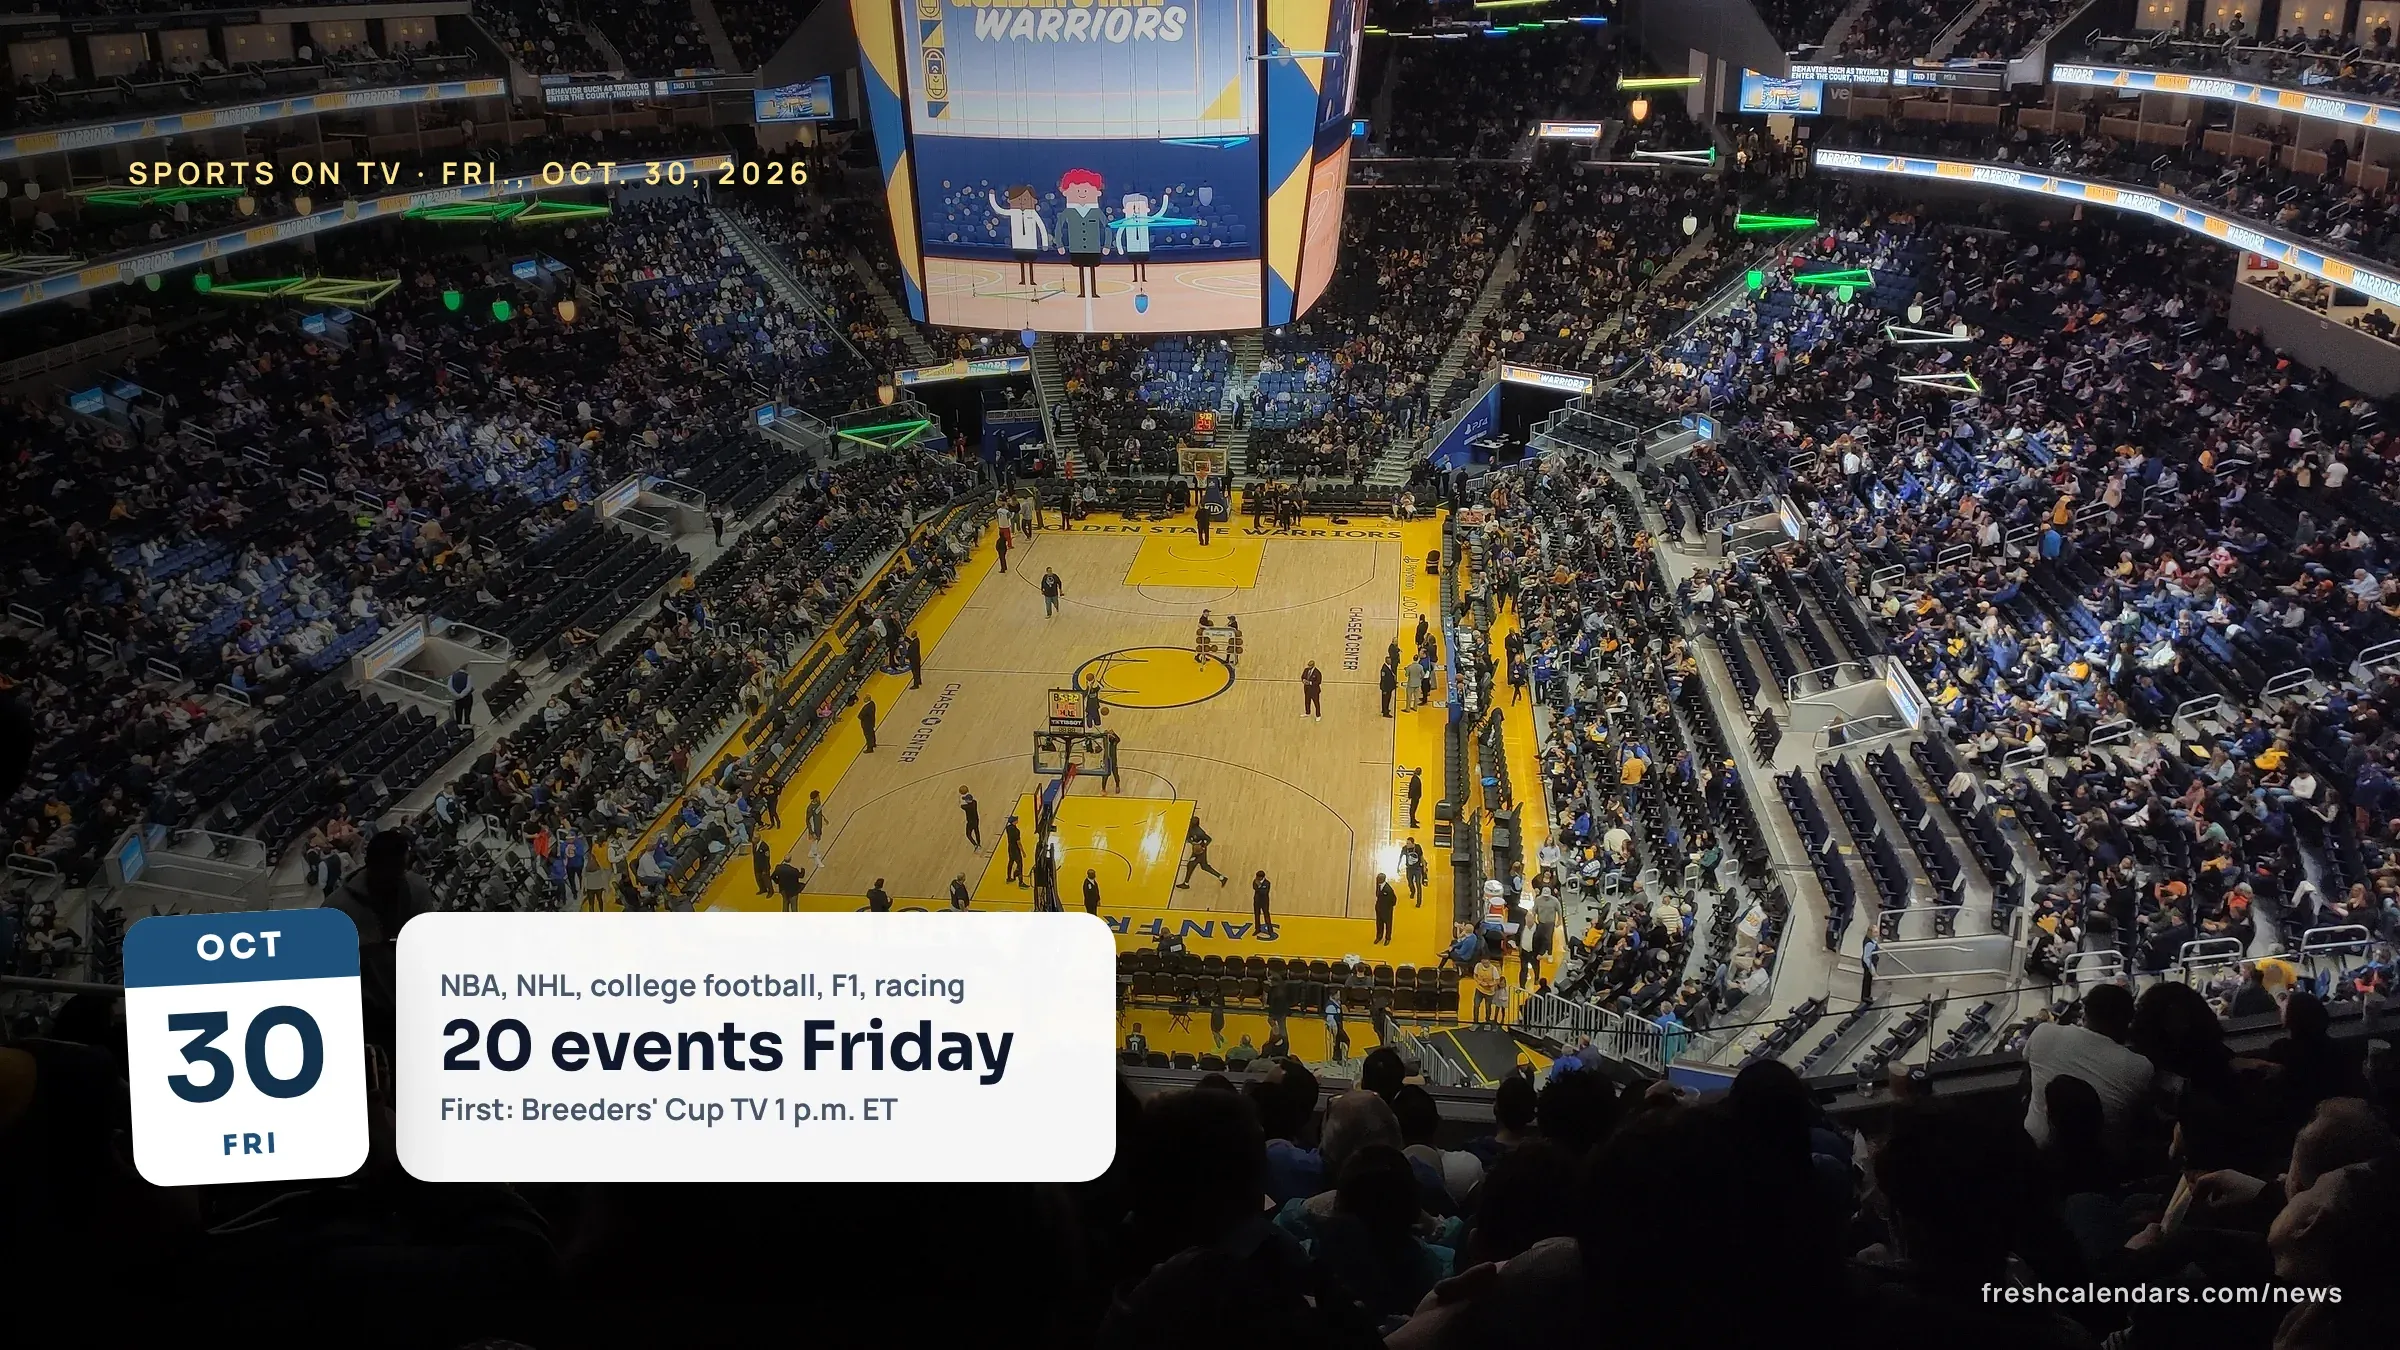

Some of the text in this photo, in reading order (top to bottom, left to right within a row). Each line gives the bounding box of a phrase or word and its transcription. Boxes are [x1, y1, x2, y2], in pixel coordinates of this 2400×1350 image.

[974, 6, 1188, 43] WARRIORS
[1791, 65, 1828, 74] BEHAVIOR
[1828, 66, 1845, 74] SUCH
[1845, 67, 1855, 75] AS
[1855, 68, 1879, 76] TRYING
[1791, 72, 1813, 80] ENTER
[1814, 73, 1828, 81] THE
[1829, 74, 1852, 83] COURT,
[1852, 74, 1889, 83] THROWING
[545, 86, 583, 97] BEHAVIOR
[583, 85, 602, 94] SUCH
[603, 84, 613, 92] AS
[613, 83, 639, 91] TRYING
[546, 89, 650, 103] ENTER THE COURT, THROWING
[2189, 77, 2236, 97] WARRIORS
[346, 89, 400, 105] WARRIORS
[2303, 96, 2346, 117] WARRIORS
[213, 107, 261, 125] WARRIORS
[58, 126, 116, 147] WARRIORS
[1973, 167, 2021, 185] WARRIORS
[2116, 191, 2162, 213] WARRIORS
[277, 216, 321, 237] WARRIORS
[2227, 225, 2265, 250] WARRIORS
[1540, 373, 1585, 389] WARRIORS
[1472, 418, 1488, 430] PS4
[1243, 528, 1402, 539] WARRIORS
[1343, 607, 1363, 671] CHASE CENTER
[897, 683, 961, 763] CHASE CENTER
